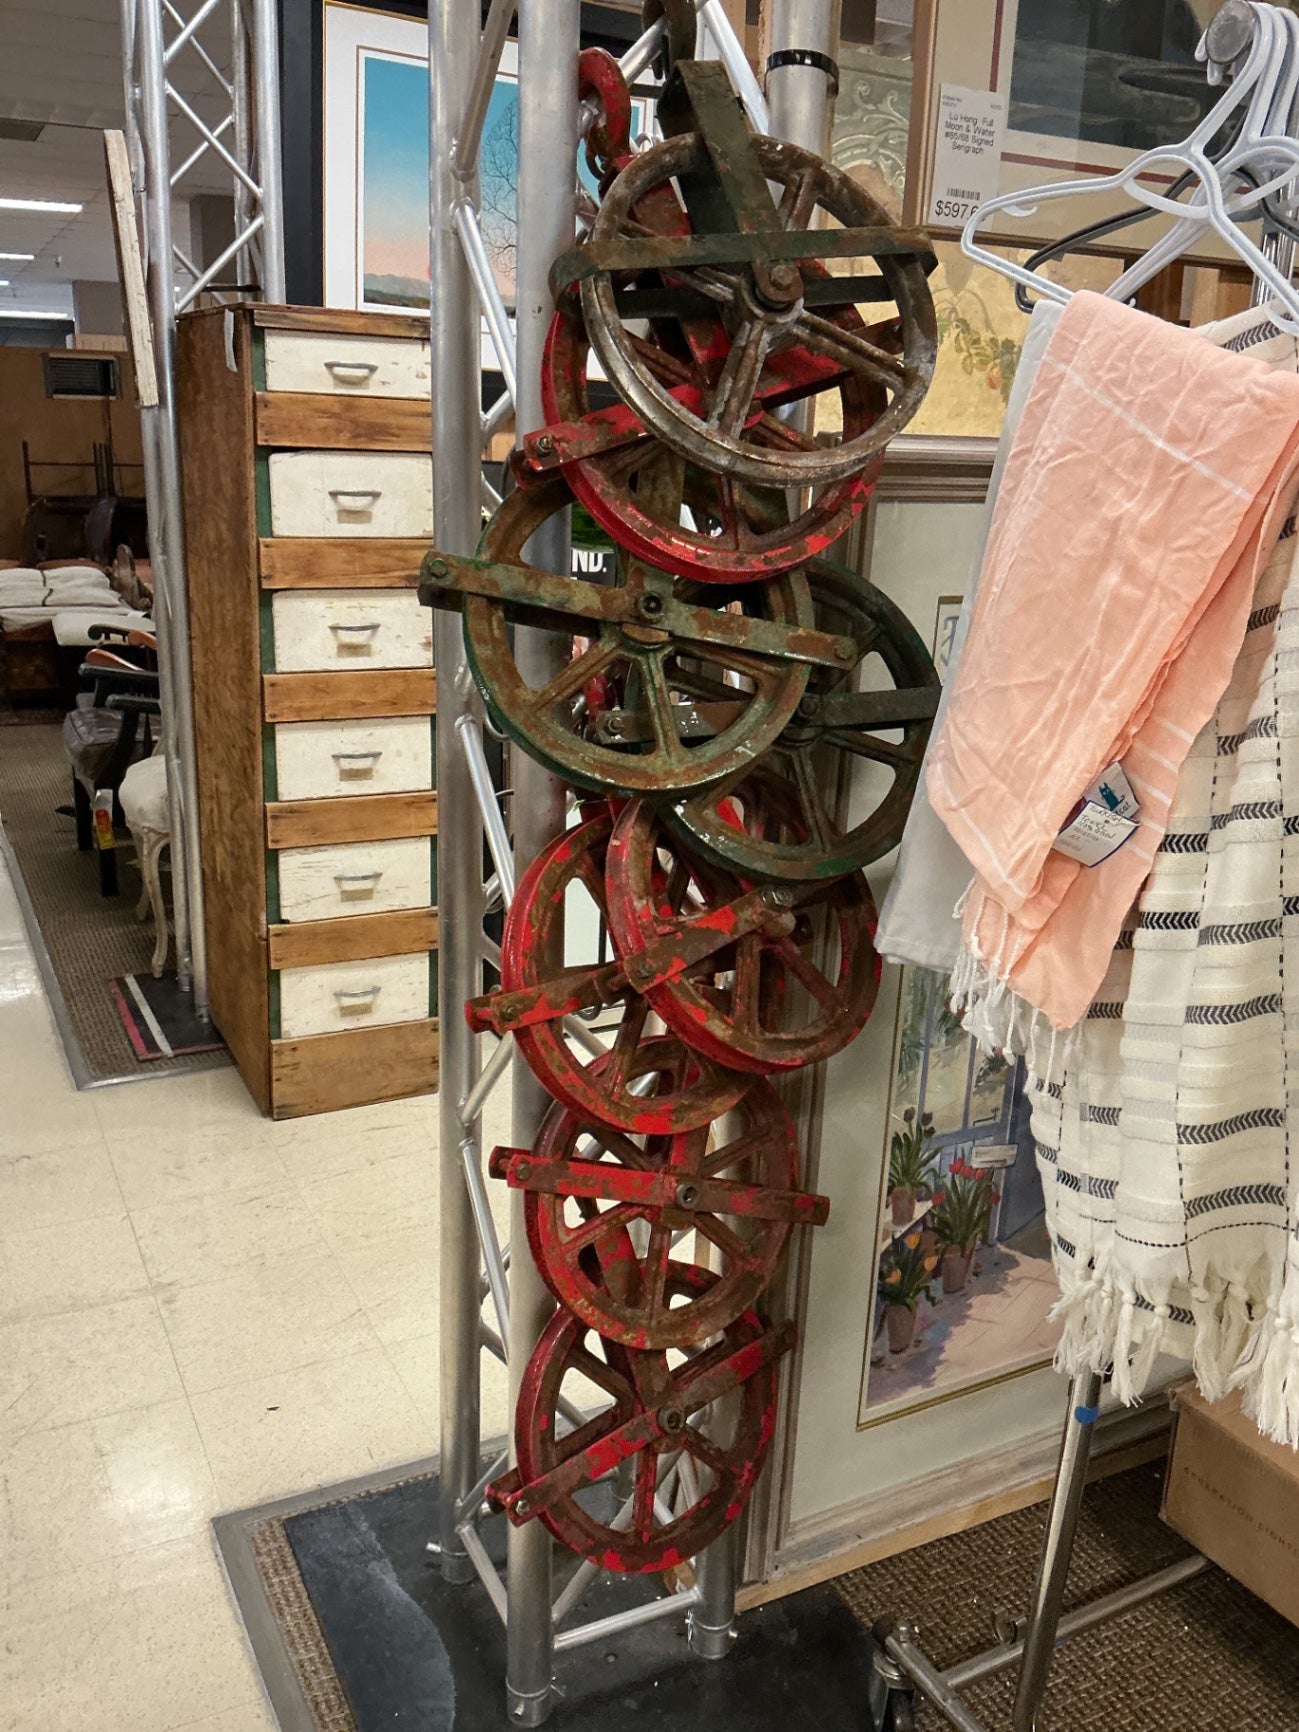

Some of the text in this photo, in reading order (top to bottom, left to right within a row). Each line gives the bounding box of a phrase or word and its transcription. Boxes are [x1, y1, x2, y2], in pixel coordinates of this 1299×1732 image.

[945, 120, 963, 132] Moon
[973, 125, 995, 137] Water
[971, 134, 994, 147] Signed
